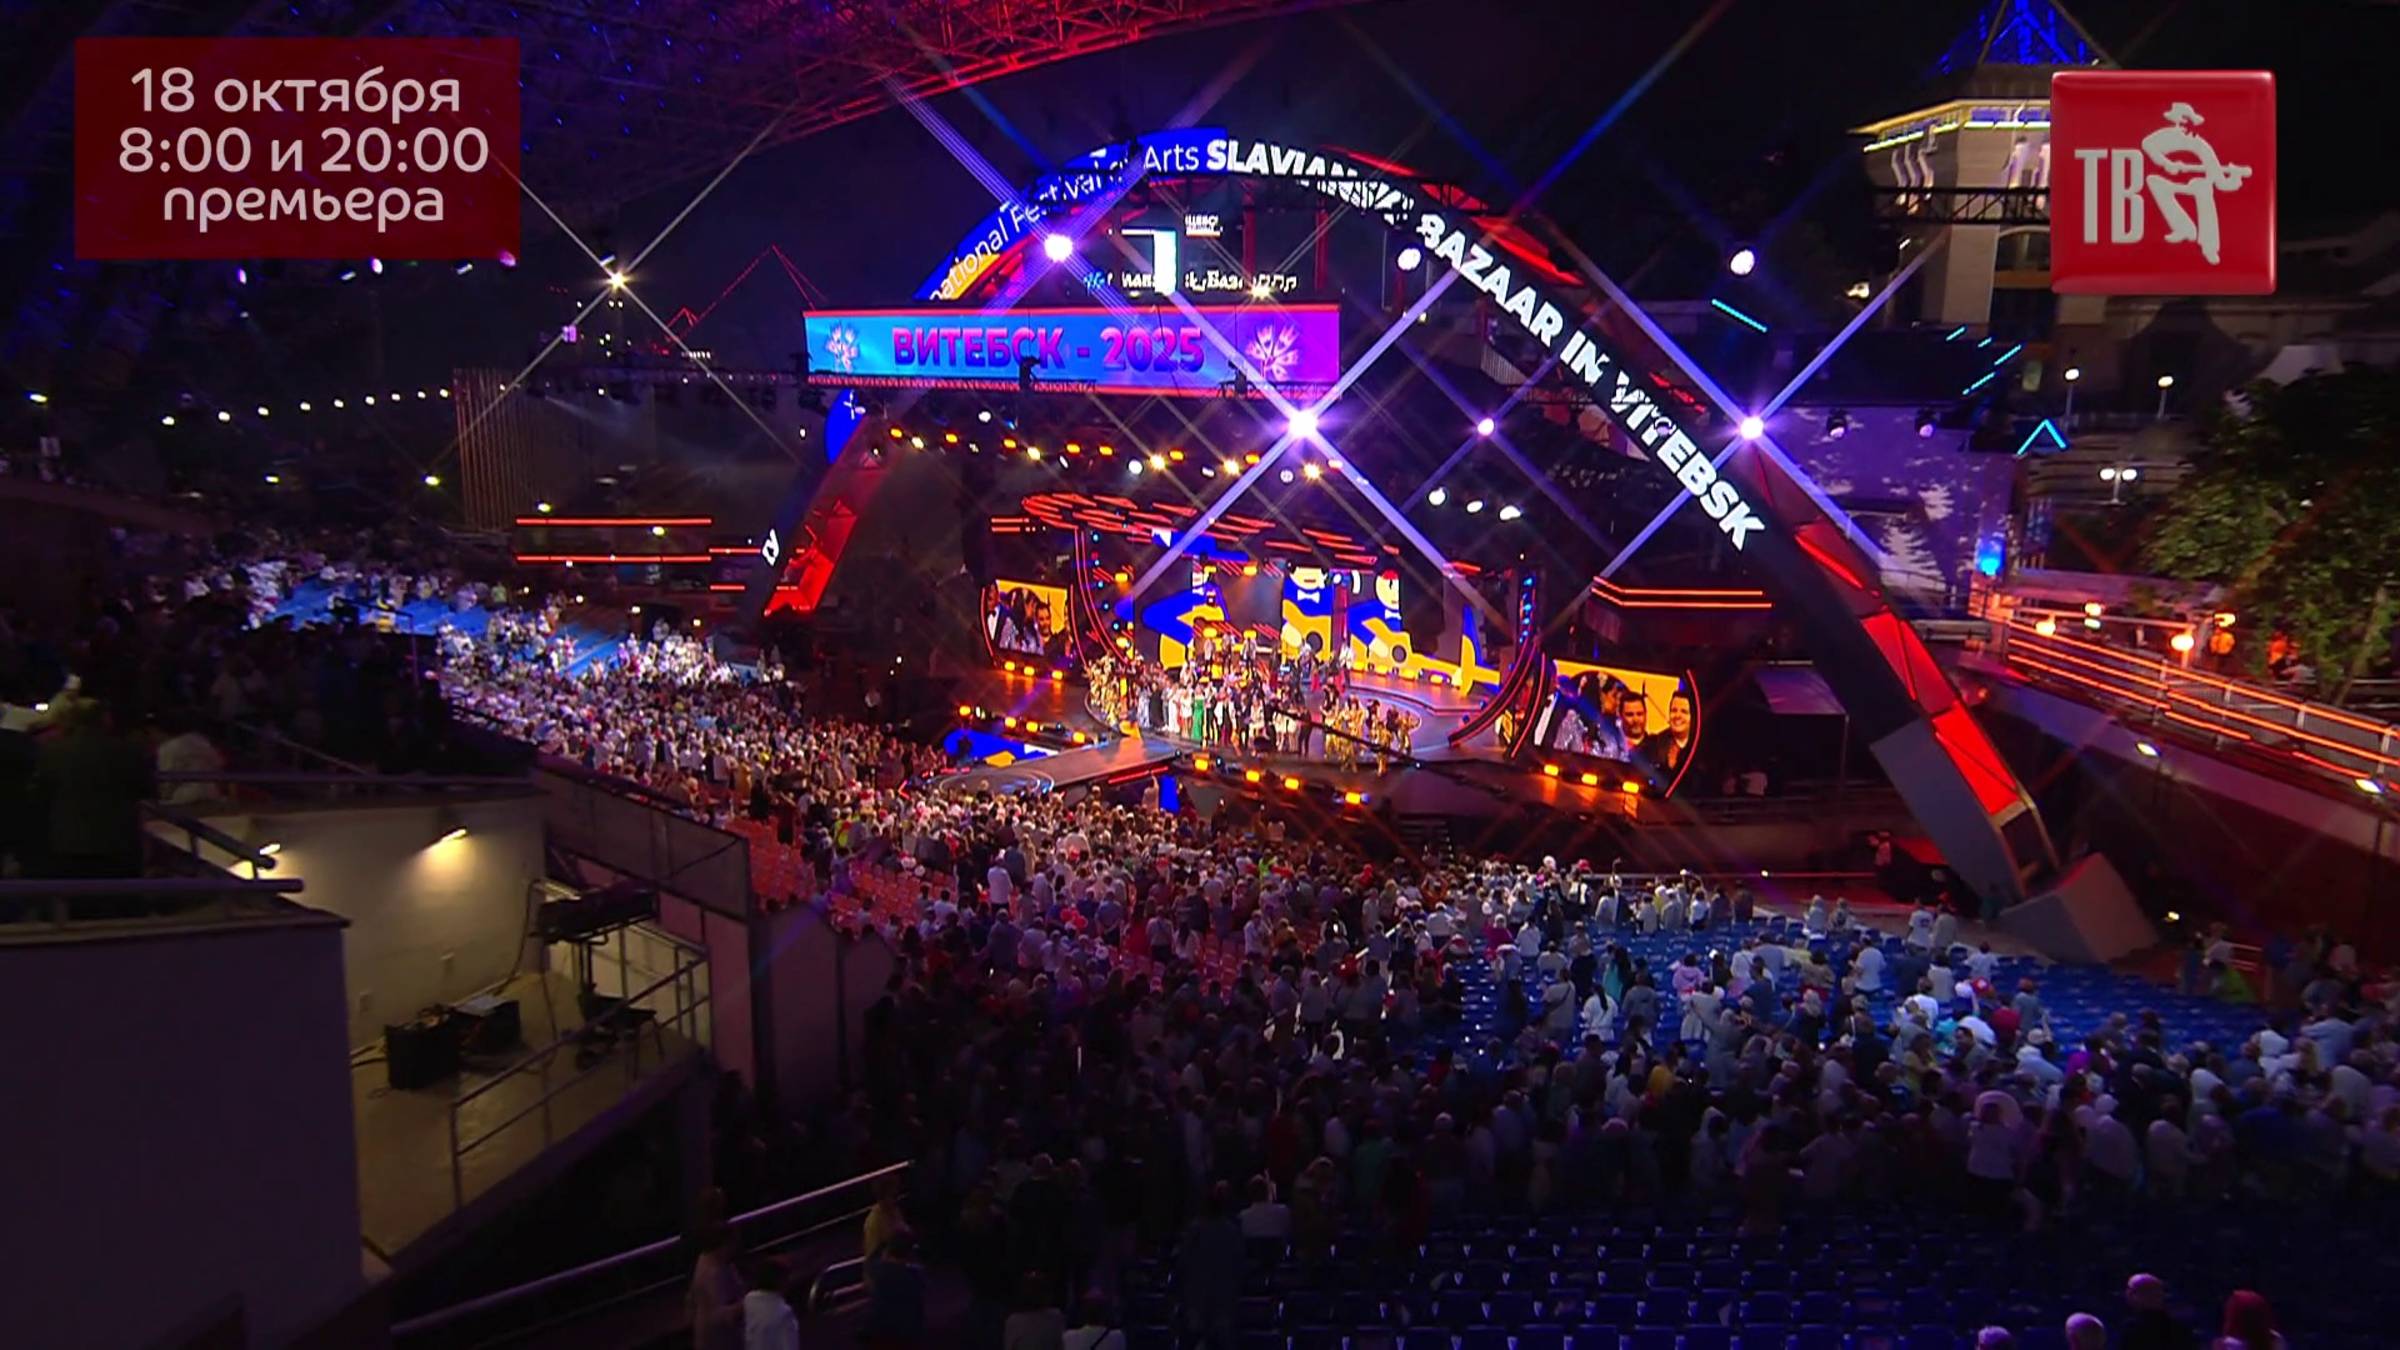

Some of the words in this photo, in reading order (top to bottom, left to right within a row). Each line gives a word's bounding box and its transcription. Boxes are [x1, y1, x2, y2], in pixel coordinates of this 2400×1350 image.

[892, 326, 1064, 371] ВИТЕБСК
[1101, 326, 1205, 373] 2025
[1144, 145, 1200, 173] Arts
[1416, 213, 1564, 347] BAZAAR
[1559, 330, 1610, 386] IN
[1610, 370, 1766, 551] VITEBSK
